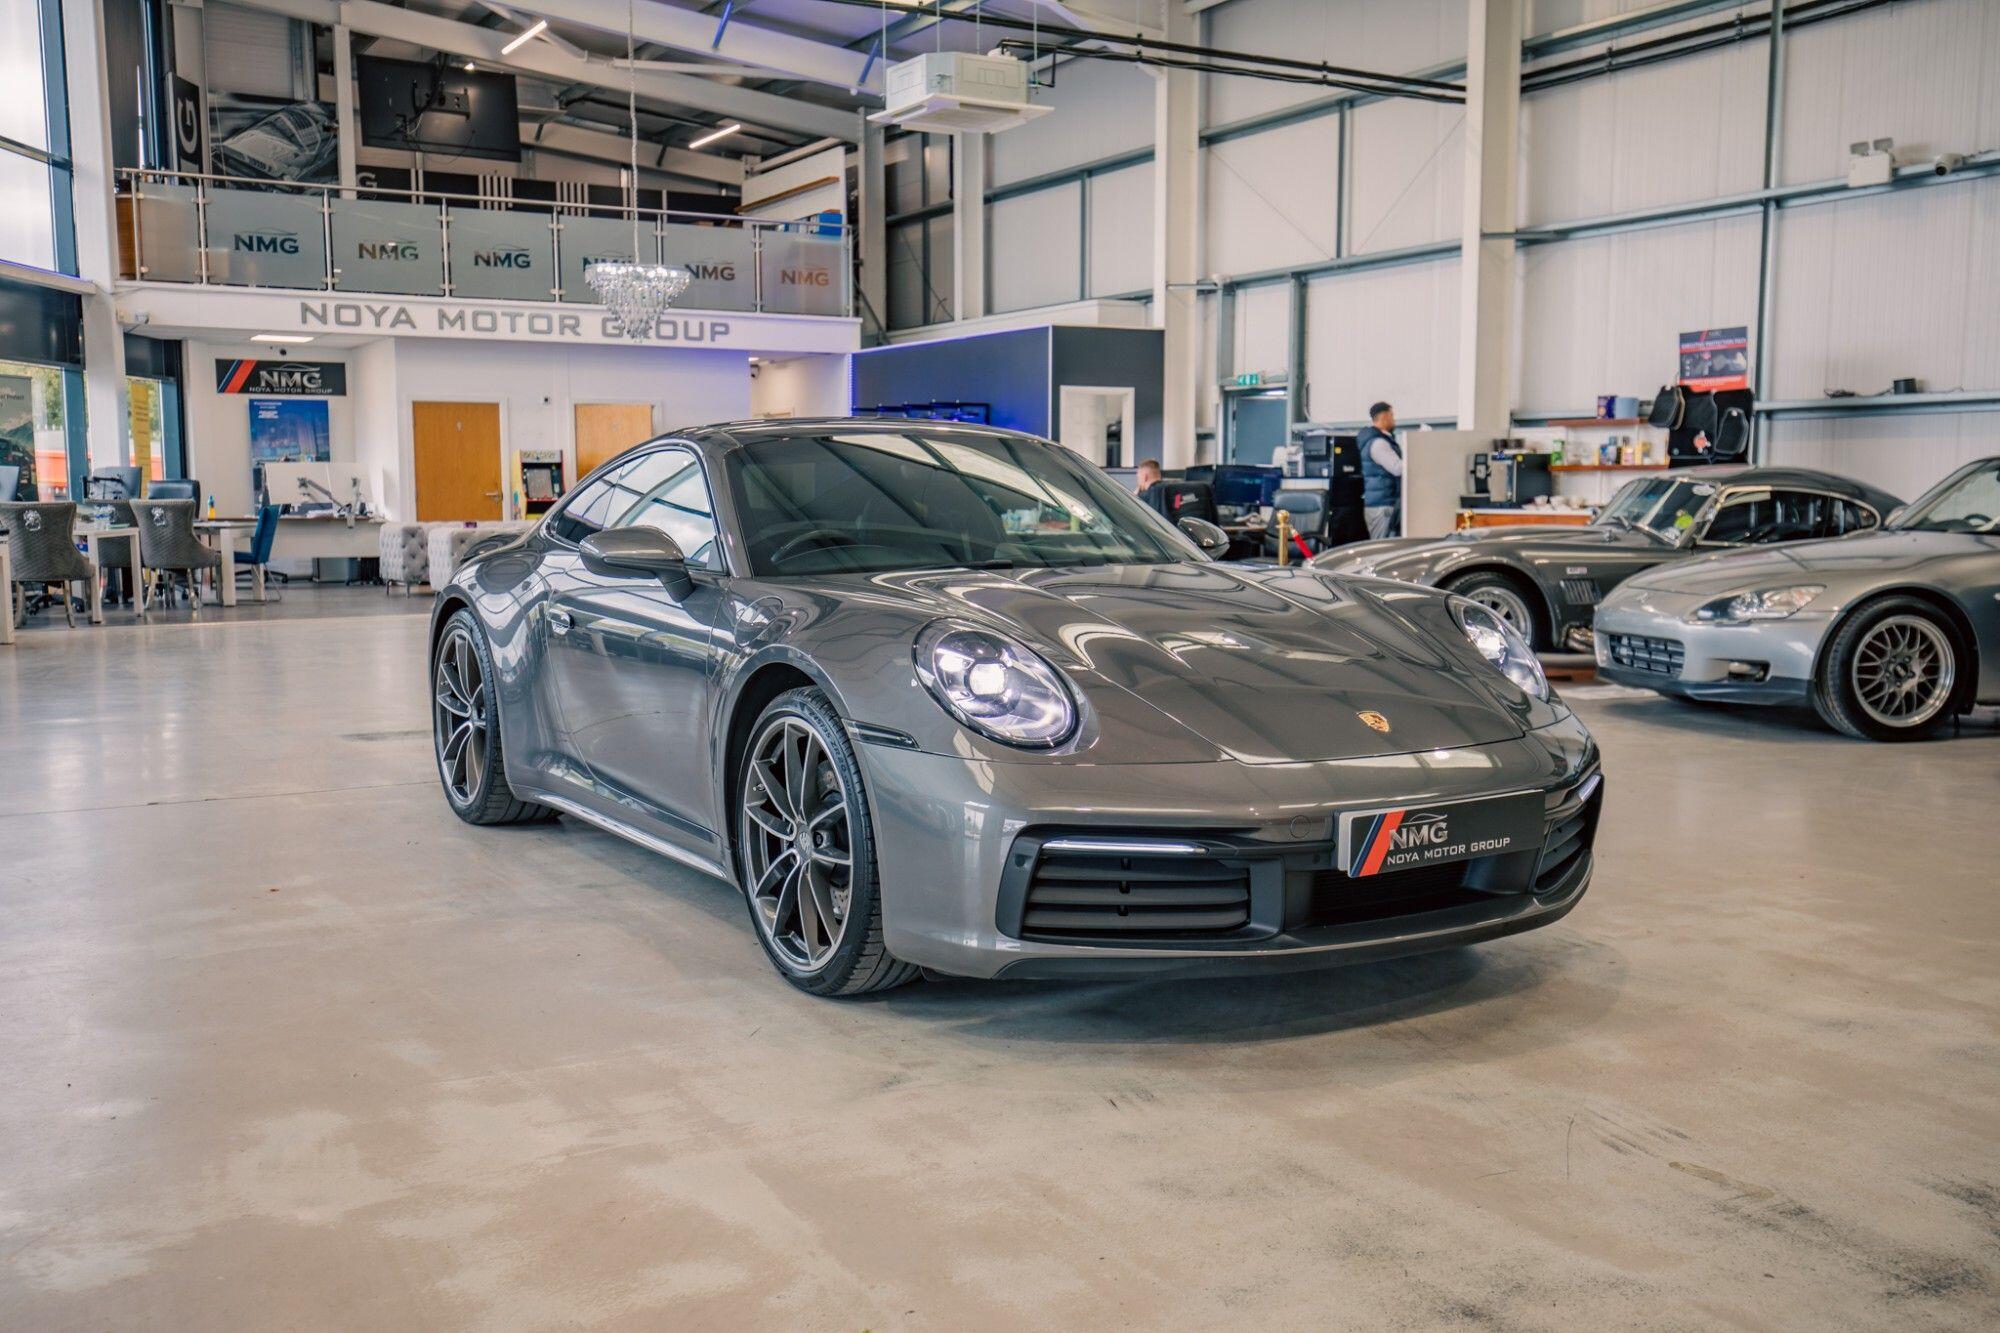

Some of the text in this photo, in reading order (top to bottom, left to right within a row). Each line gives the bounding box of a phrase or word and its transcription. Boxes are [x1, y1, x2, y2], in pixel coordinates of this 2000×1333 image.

[234, 234, 299, 254] NMG
[358, 243, 418, 260] NMG
[474, 251, 531, 268] NMG
[685, 264, 735, 281] NMG
[781, 269, 829, 286] NMG
[301, 303, 416, 329] NOYA
[438, 308, 581, 337] MOTOR
[259, 371, 321, 388] NMG
[1389, 822, 1448, 850] NMG
[1387, 837, 1511, 866] NOYA MOTOR GROUP
